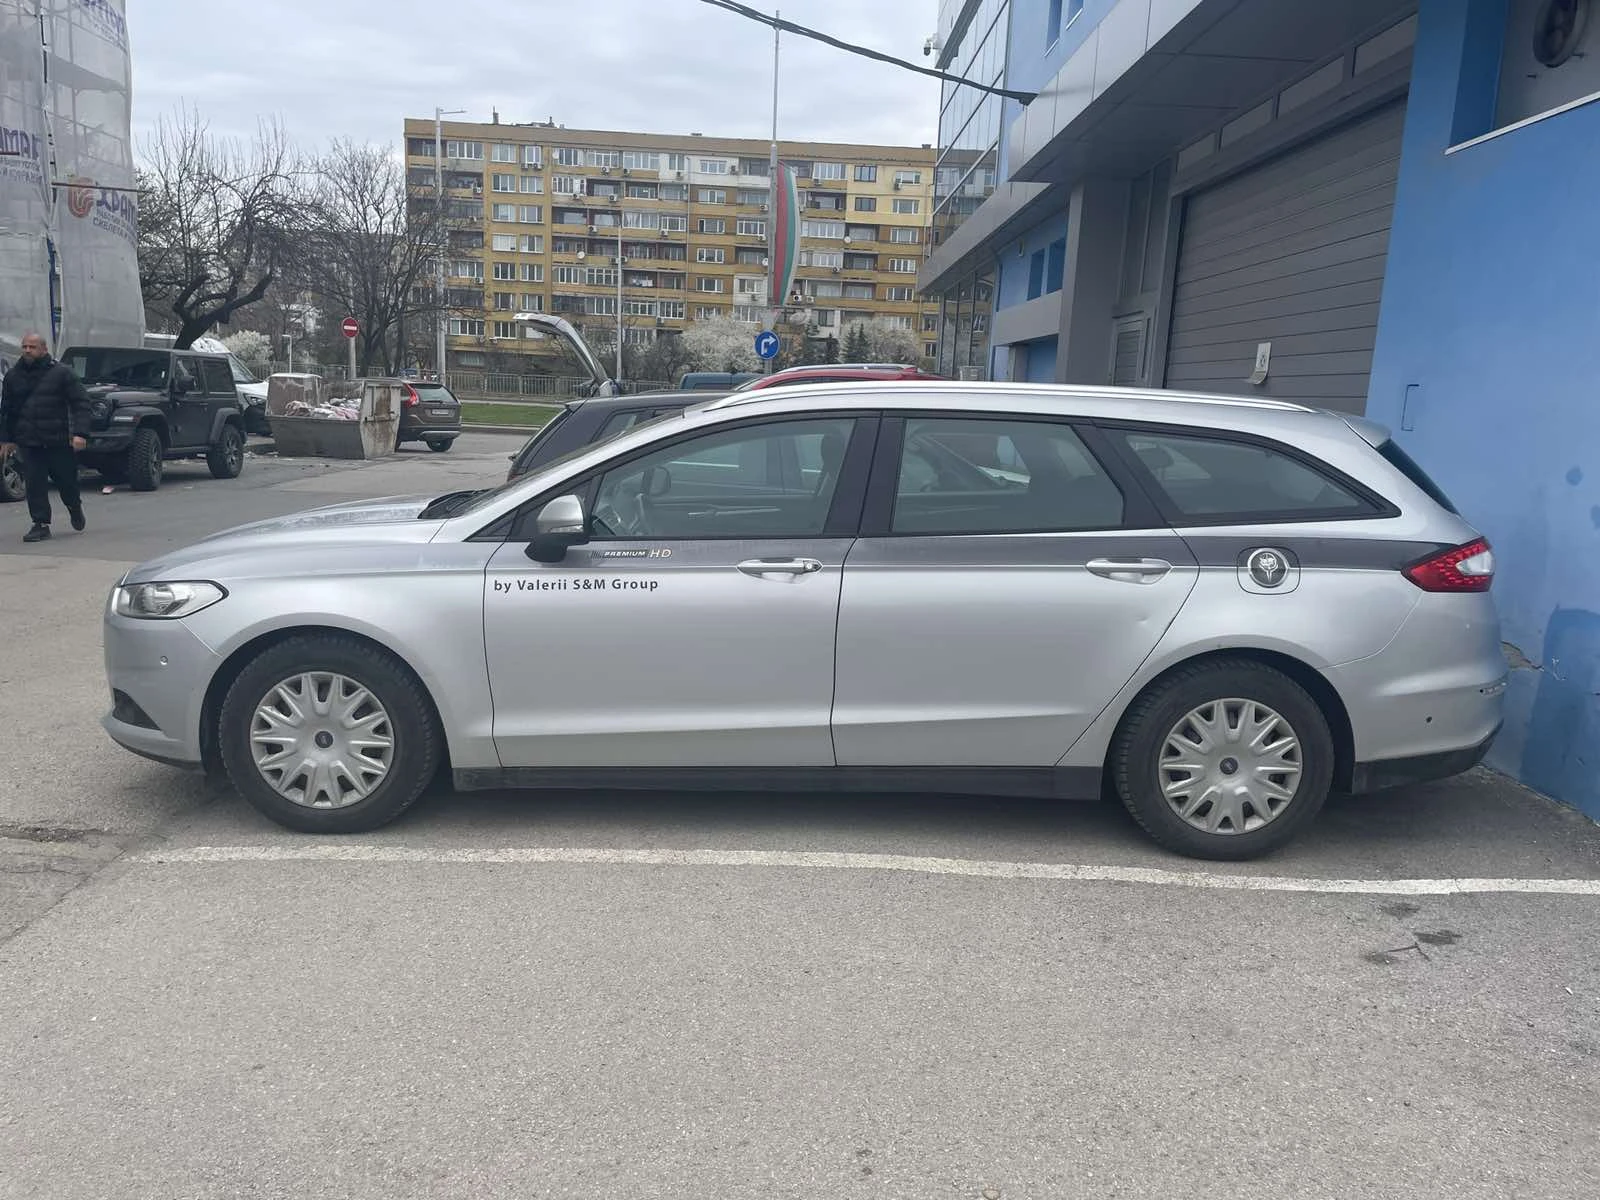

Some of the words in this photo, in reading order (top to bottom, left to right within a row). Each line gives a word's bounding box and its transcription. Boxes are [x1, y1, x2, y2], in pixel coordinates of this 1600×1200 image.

[649, 548, 673, 558] HD
[494, 579, 512, 593] by
[517, 579, 567, 590] Valerii
[573, 579, 606, 590] S&M
[612, 579, 659, 592] Group
